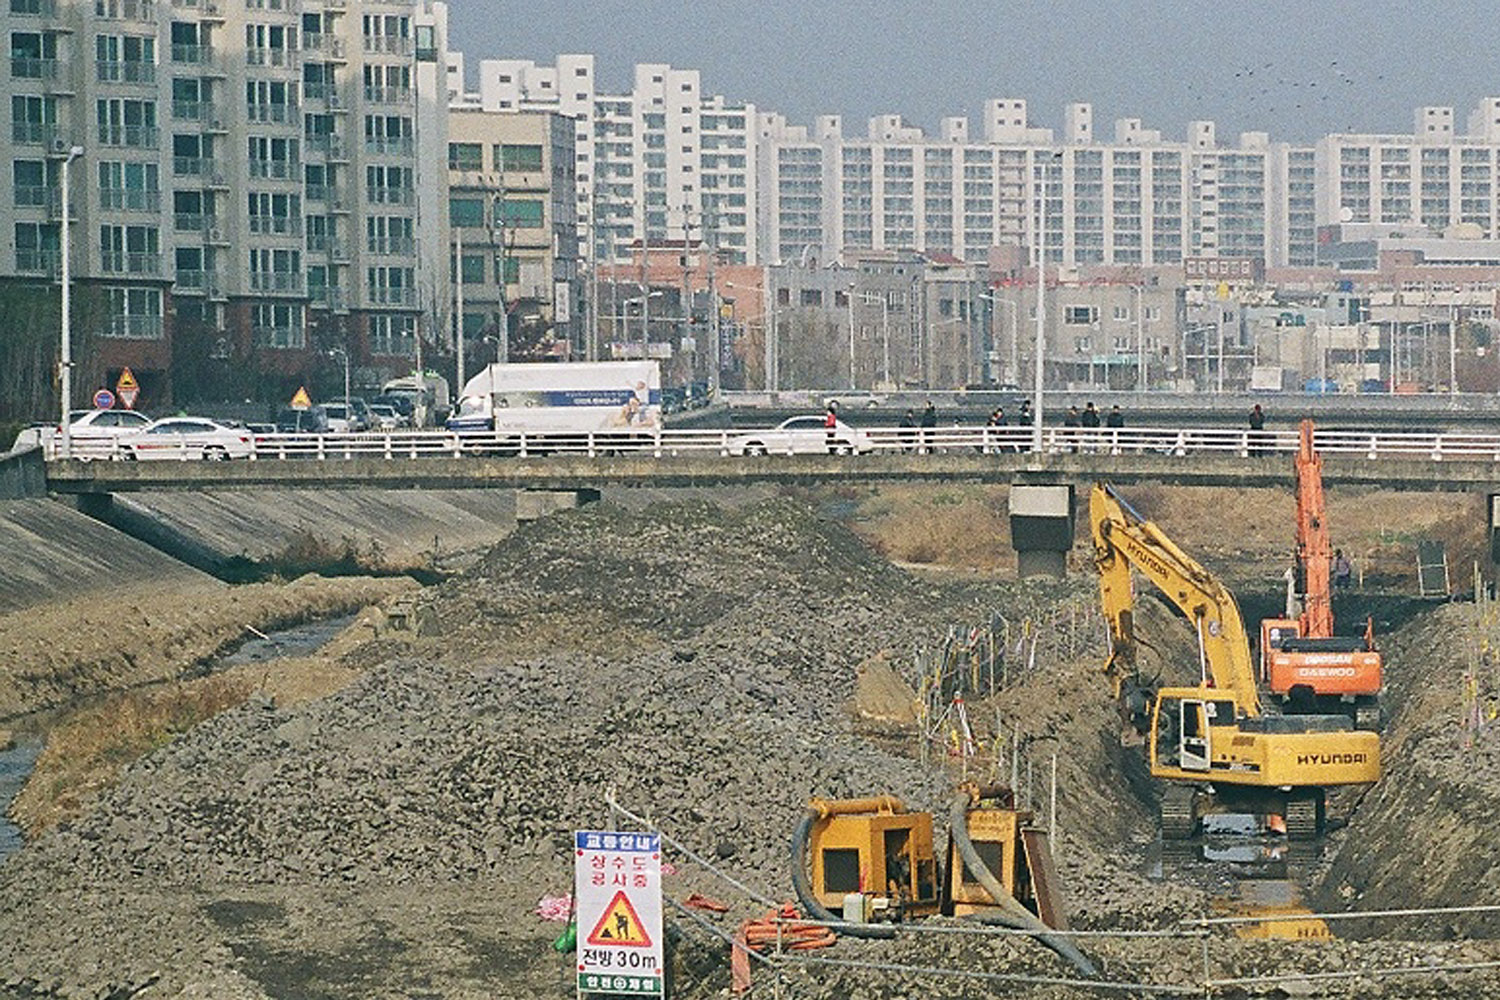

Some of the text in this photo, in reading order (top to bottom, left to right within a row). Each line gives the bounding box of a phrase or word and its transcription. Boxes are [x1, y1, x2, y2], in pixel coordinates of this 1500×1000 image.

[1127, 542, 1171, 580] HYUNDAI
[1298, 668, 1355, 677] DAEWOO
[1297, 753, 1367, 765] HYUNDAI
[586, 834, 650, 850] 교통안내
[590, 854, 647, 870] 상수도
[591, 871, 648, 888] 공사중
[583, 948, 657, 969] 전방 30m
